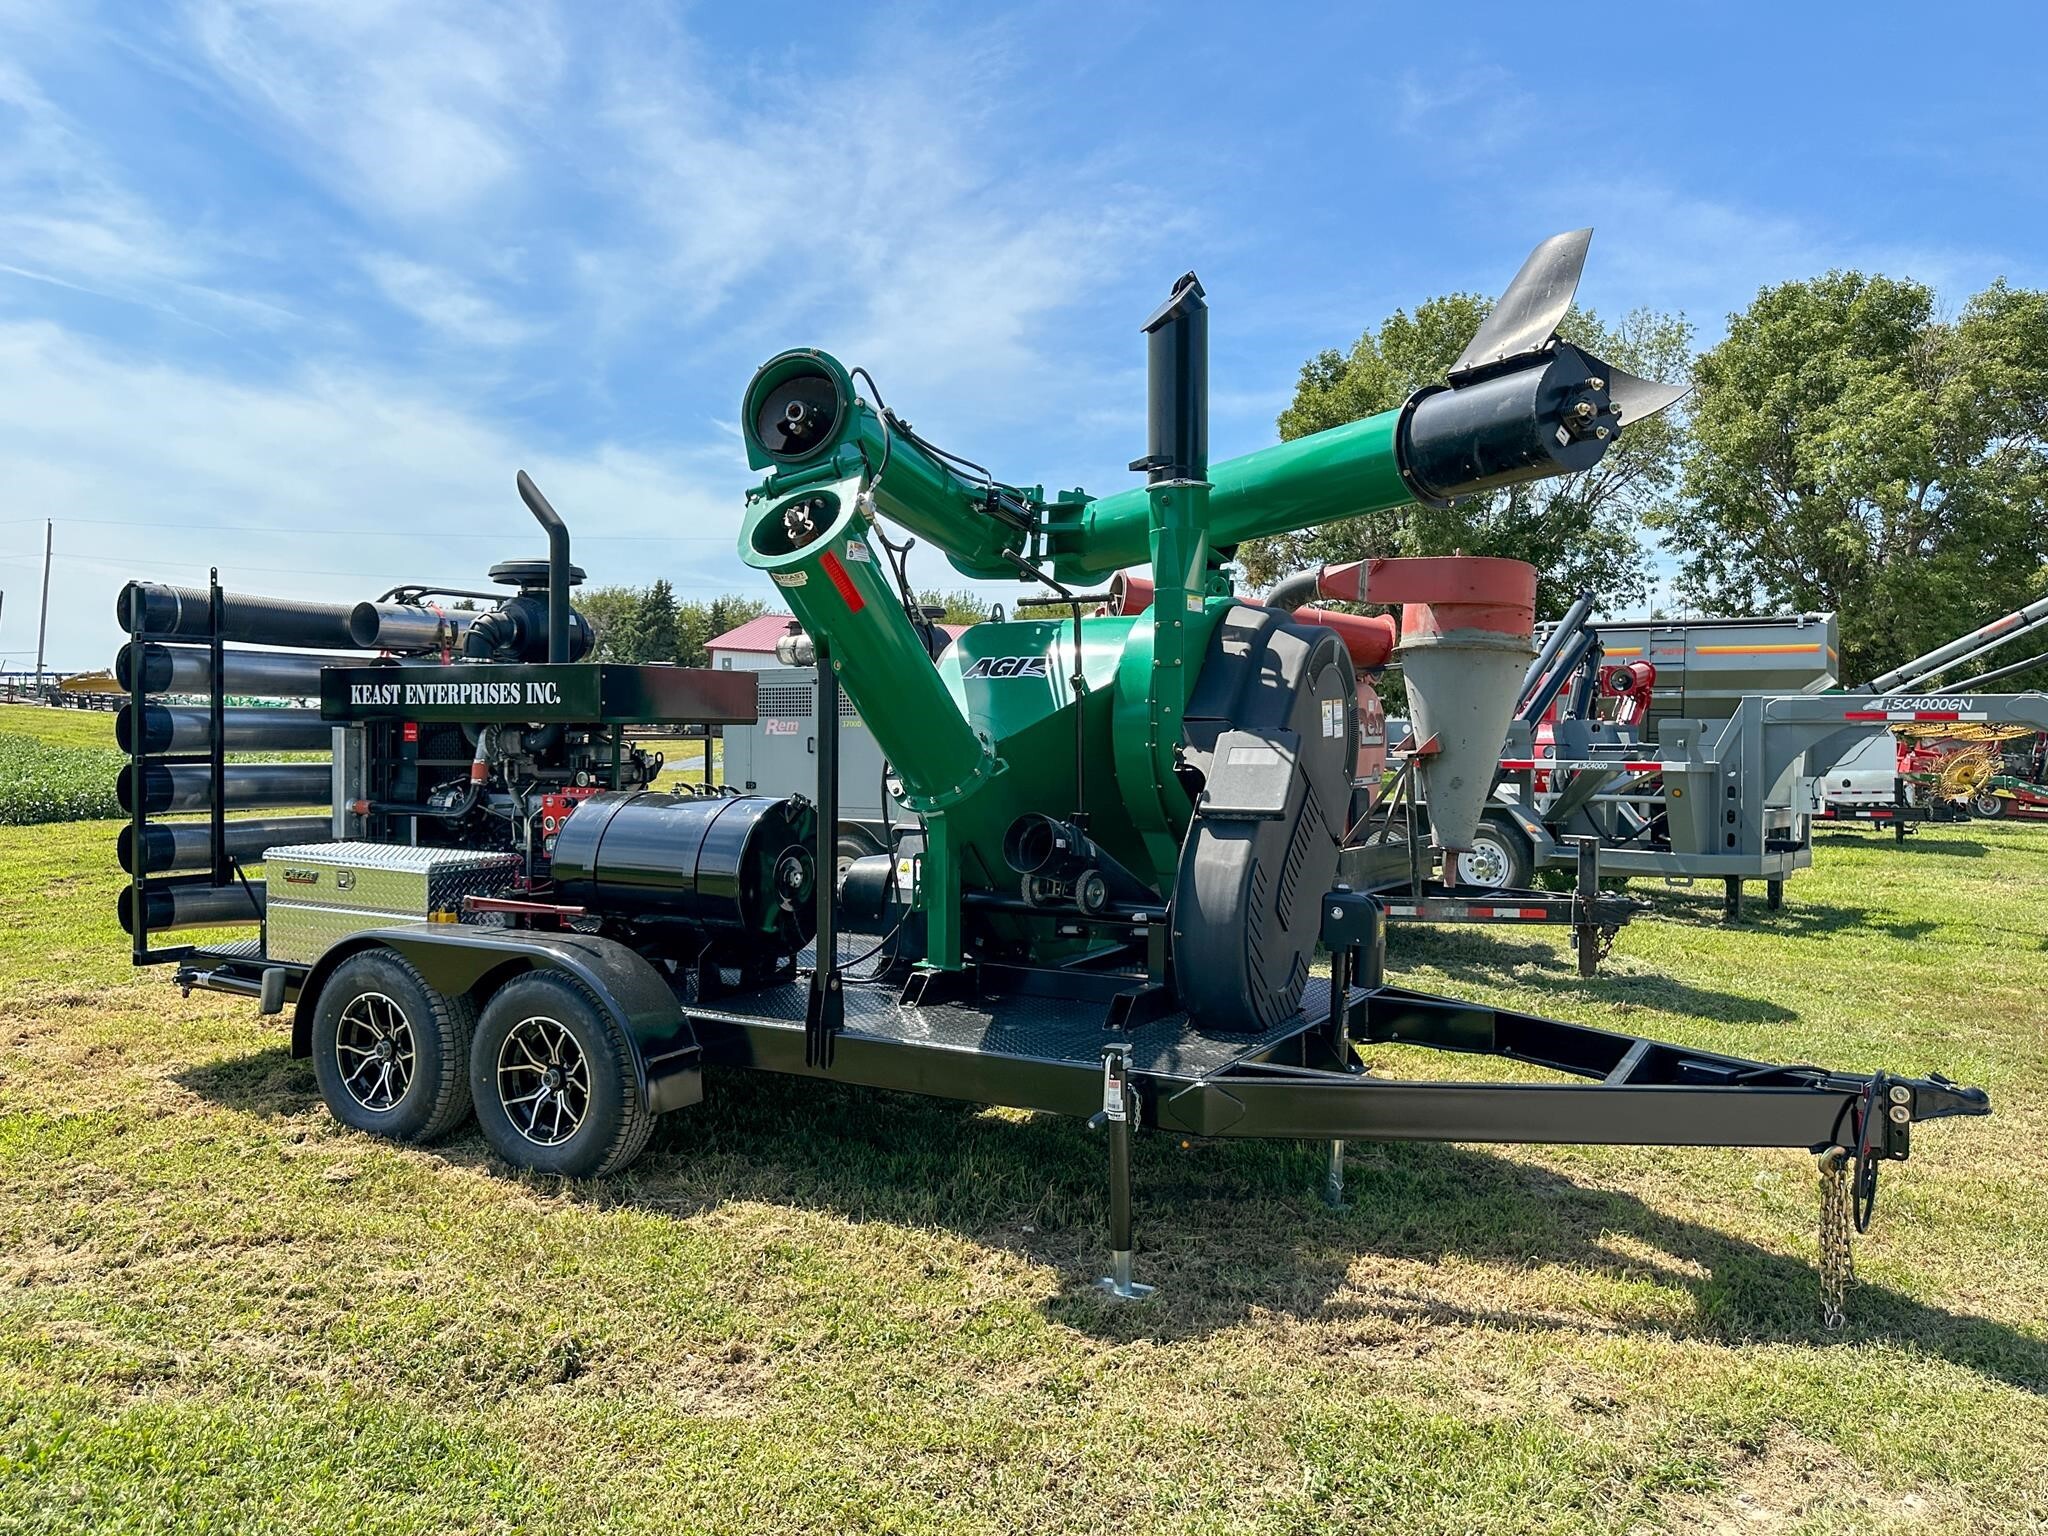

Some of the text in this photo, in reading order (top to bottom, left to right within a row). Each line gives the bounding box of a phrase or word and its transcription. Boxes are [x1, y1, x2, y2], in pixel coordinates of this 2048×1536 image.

[962, 656, 1031, 678] AGI
[350, 682, 561, 705] KEAST ENTERPRISES INC.
[765, 720, 799, 735] Rem
